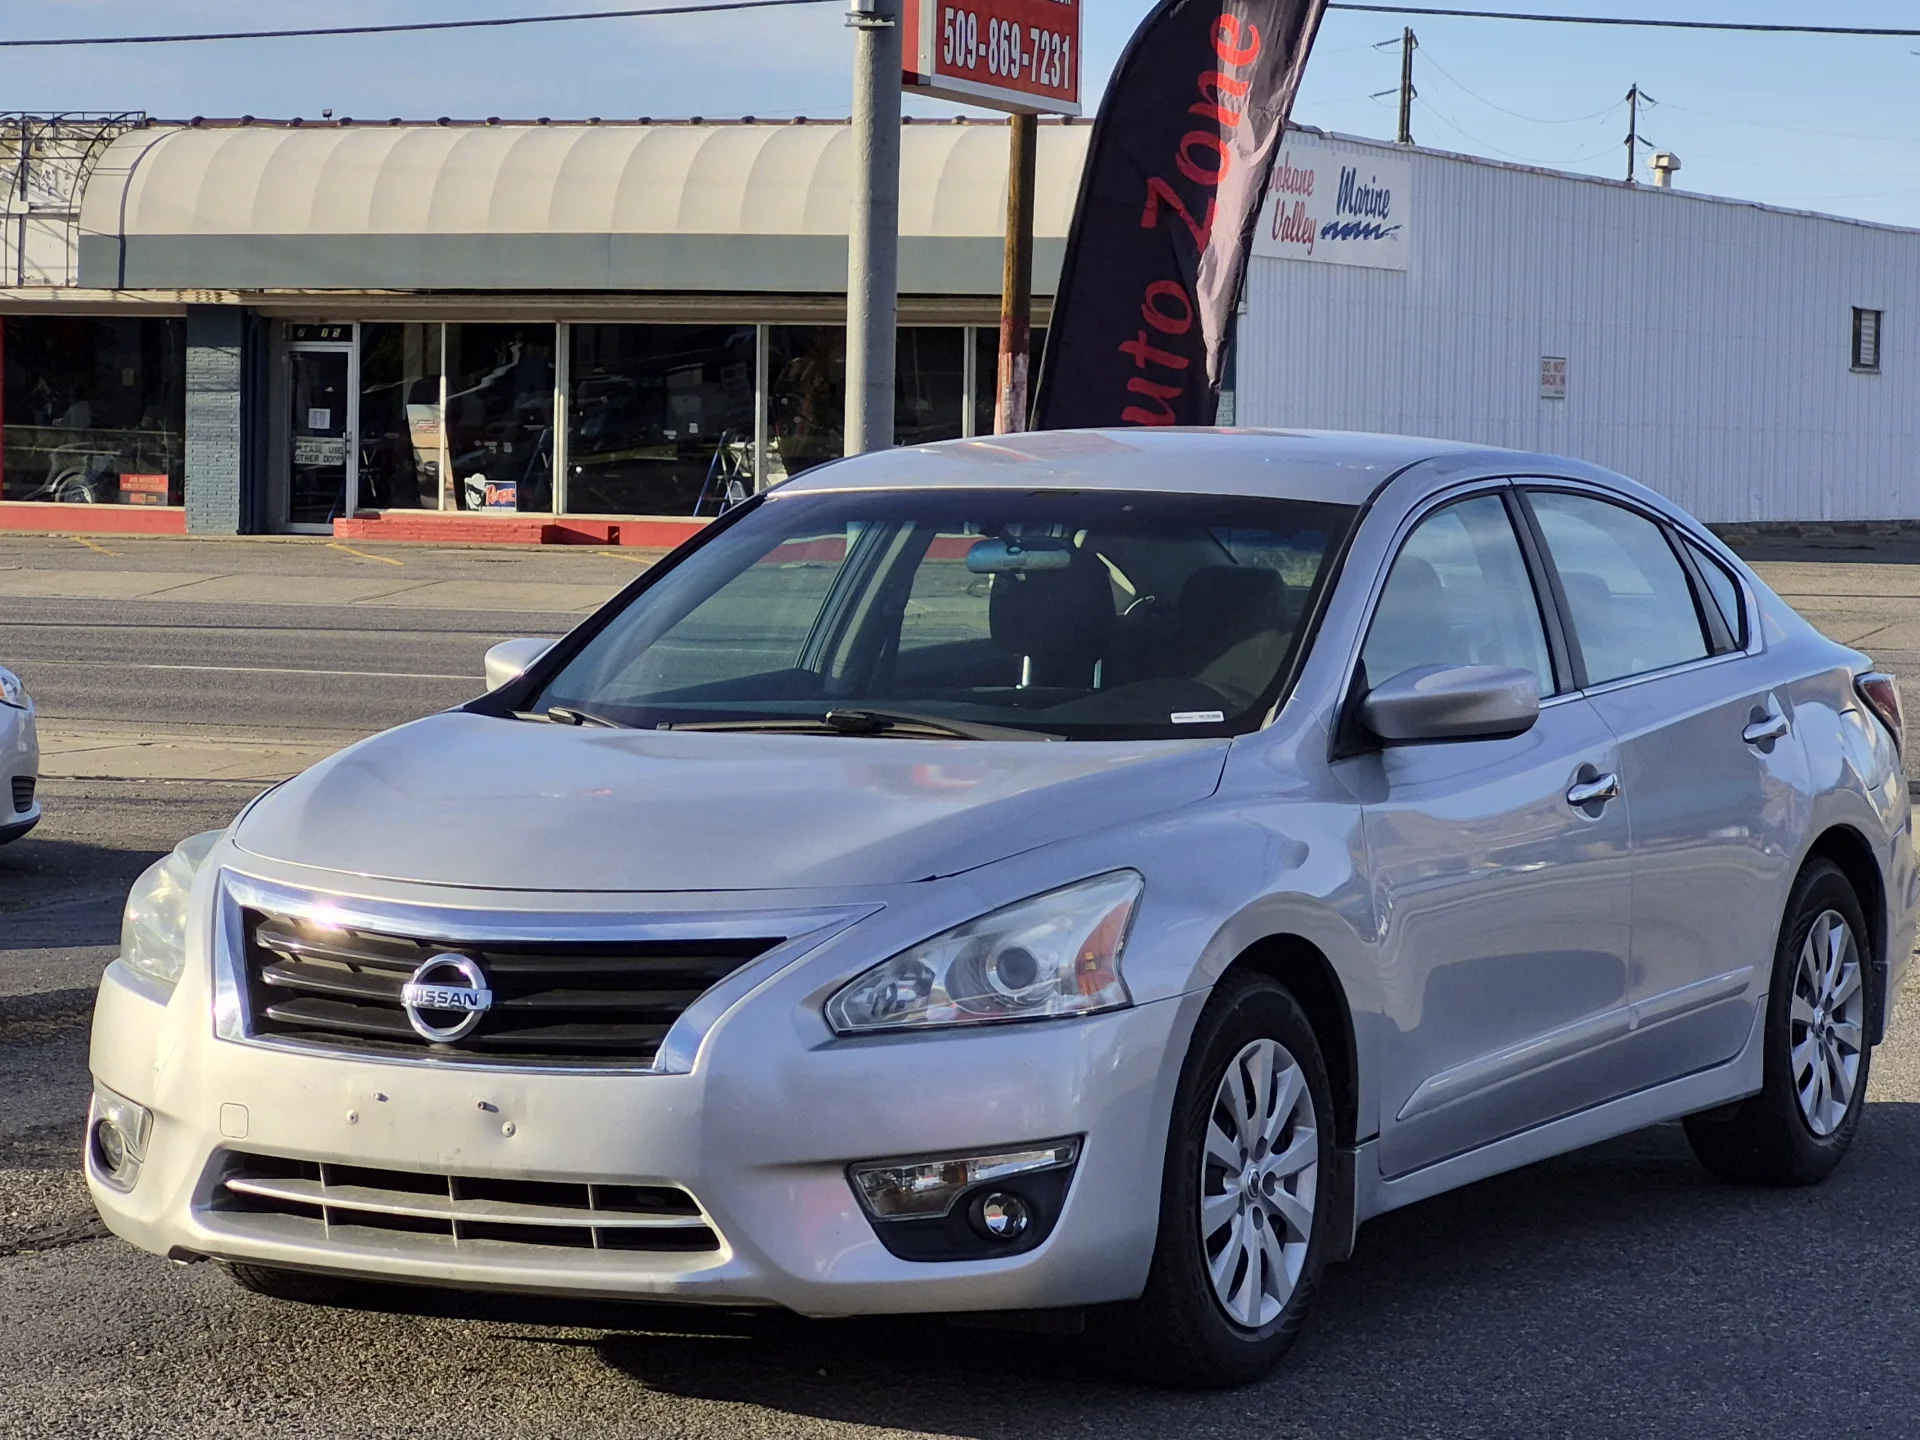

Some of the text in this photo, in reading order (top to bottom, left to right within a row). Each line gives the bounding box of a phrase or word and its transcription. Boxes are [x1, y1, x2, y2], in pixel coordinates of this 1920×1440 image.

[943, 7, 1070, 90] 509-869-7231
[1266, 151, 1315, 200] pokane
[1336, 165, 1391, 220] Marine
[1118, 12, 1262, 427] uto Zone
[1271, 197, 1317, 256] Valley
[295, 454, 320, 463] OTHER
